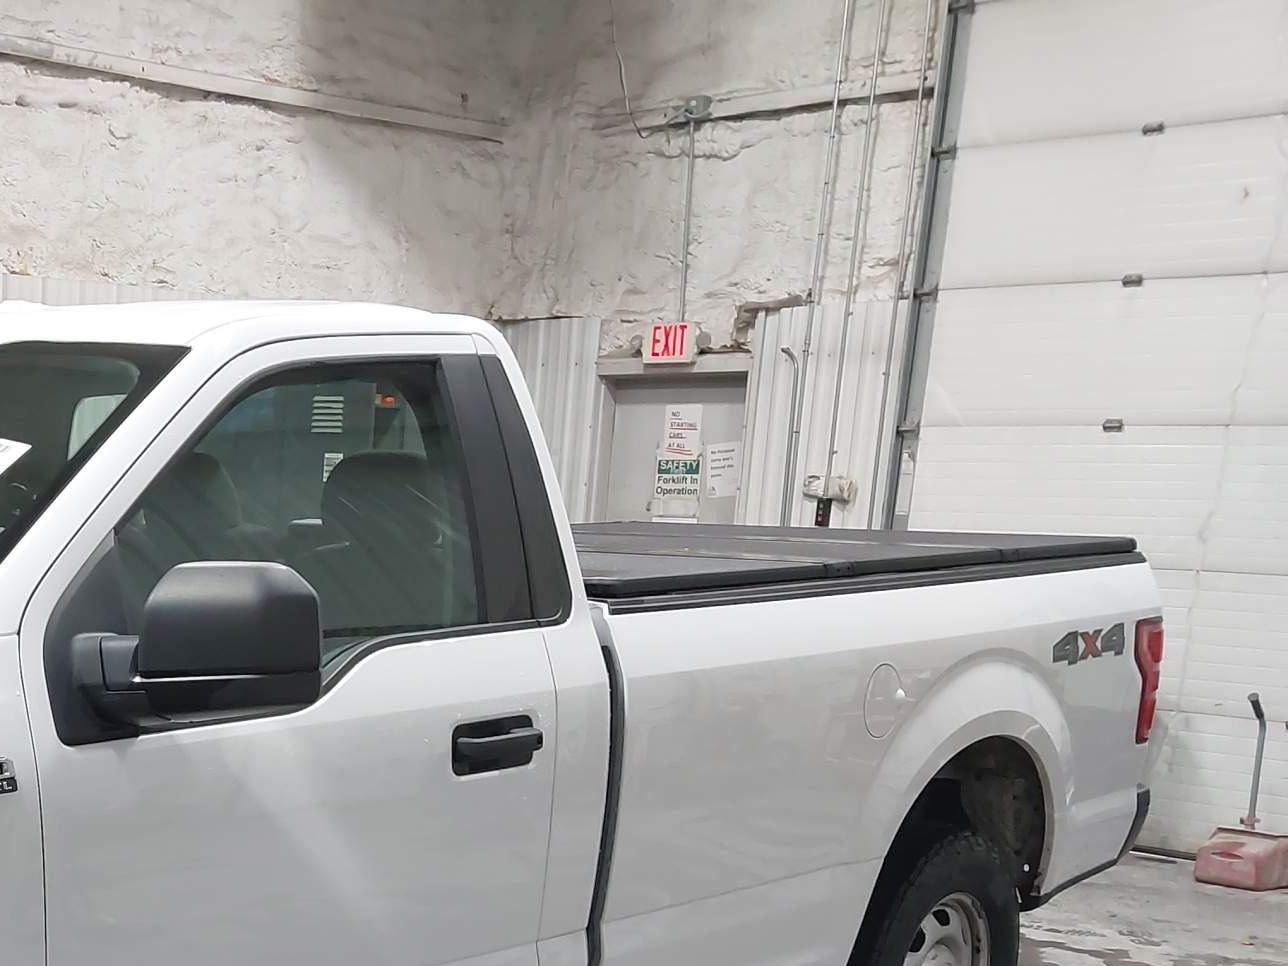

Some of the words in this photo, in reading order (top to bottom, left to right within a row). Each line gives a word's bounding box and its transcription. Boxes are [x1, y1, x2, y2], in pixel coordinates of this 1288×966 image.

[651, 325, 688, 357] EXIT
[660, 461, 697, 470] SAFETY
[657, 475, 688, 485] Forklift
[690, 475, 698, 485] In
[656, 486, 698, 496] Operation
